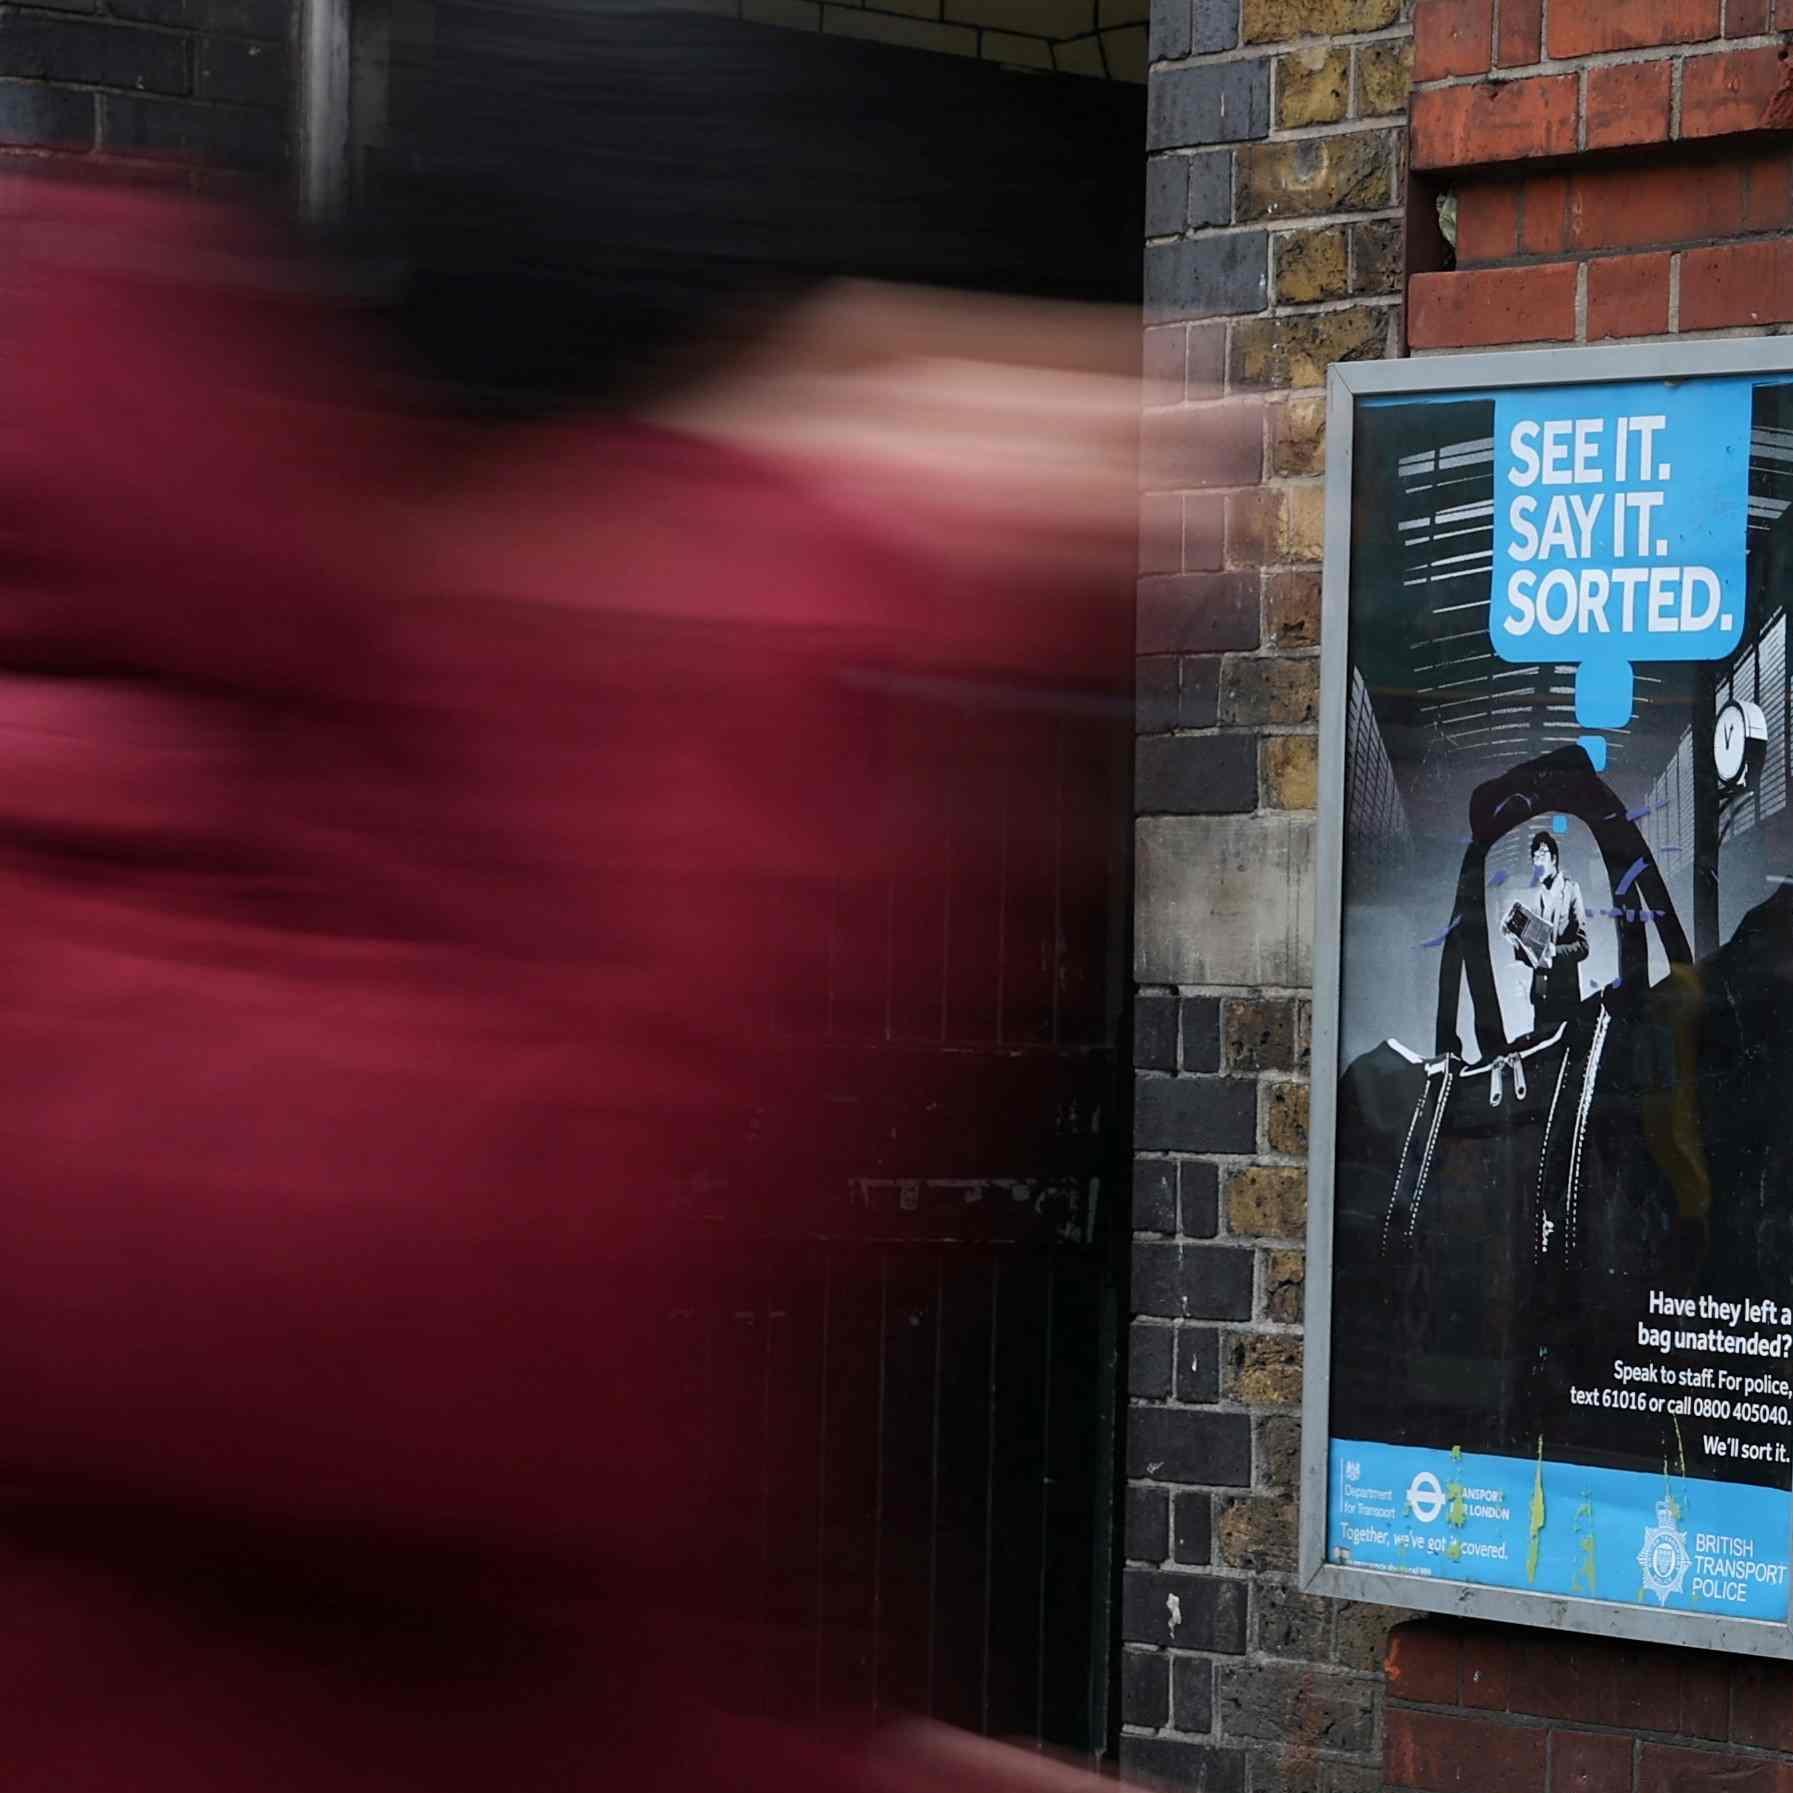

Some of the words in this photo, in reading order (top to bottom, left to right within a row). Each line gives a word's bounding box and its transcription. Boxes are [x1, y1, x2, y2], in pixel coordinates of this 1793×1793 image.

[1507, 418, 1603, 488] SEE
[1614, 415, 1671, 482] IT.
[1507, 493, 1603, 562] SAY
[1614, 490, 1668, 558] IT.
[1503, 566, 1733, 637] SORTED.
[1649, 1290, 1696, 1317] Have
[1699, 1295, 1741, 1327] they
[1744, 1298, 1778, 1324] left
[1780, 1307, 1792, 1326] a
[1638, 1321, 1671, 1353] bag
[1674, 1329, 1793, 1358] unattended?
[1614, 1360, 1658, 1384] Speak
[1660, 1367, 1676, 1384] to
[1678, 1368, 1716, 1388] staff.
[1718, 1370, 1743, 1390] For
[1744, 1374, 1793, 1399] police,
[1570, 1386, 1600, 1406] text
[1602, 1389, 1647, 1411] 61016
[1648, 1398, 1664, 1412] or
[1667, 1397, 1692, 1415] call
[1693, 1398, 1730, 1419] 0800
[1732, 1402, 1792, 1426] 405040.
[1703, 1435, 1739, 1457] We'll
[1741, 1444, 1773, 1462] sort
[1774, 1443, 1790, 1463] it.
[1344, 1484, 1393, 1501] Department
[1458, 1486, 1504, 1503] ANSPORT
[1358, 1503, 1396, 1519] Transport
[1469, 1503, 1511, 1521] LONDON
[1340, 1521, 1391, 1547] Together,
[1393, 1530, 1425, 1549] we've
[1427, 1535, 1446, 1555] got
[1461, 1541, 1509, 1561] covered.
[1695, 1533, 1753, 1558] BRITISH
[1694, 1555, 1787, 1585] TRANSPORT
[1692, 1578, 1748, 1602] POLICE
